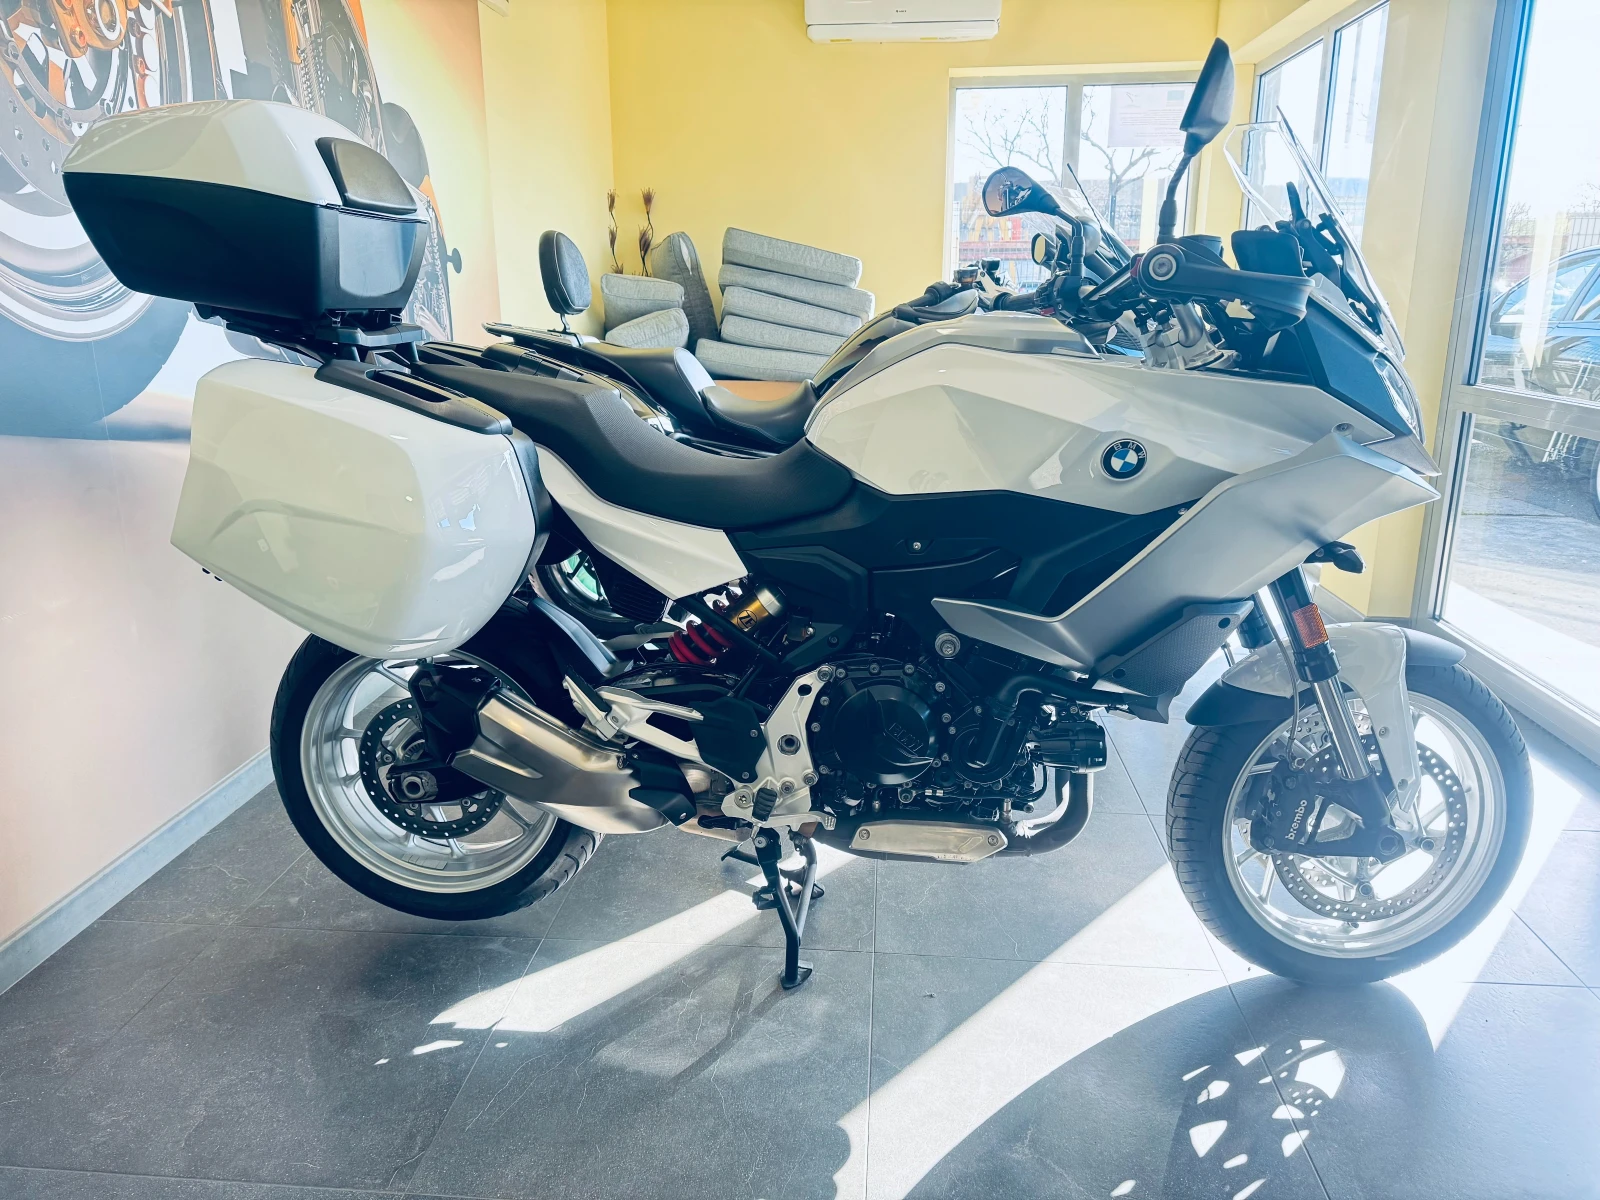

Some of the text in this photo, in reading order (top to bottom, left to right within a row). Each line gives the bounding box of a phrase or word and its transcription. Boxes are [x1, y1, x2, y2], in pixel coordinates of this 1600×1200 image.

[1113, 441, 1146, 459] BMW
[738, 609, 757, 630] ZF
[888, 722, 924, 752] BMW
[1285, 799, 1308, 840] brembo
